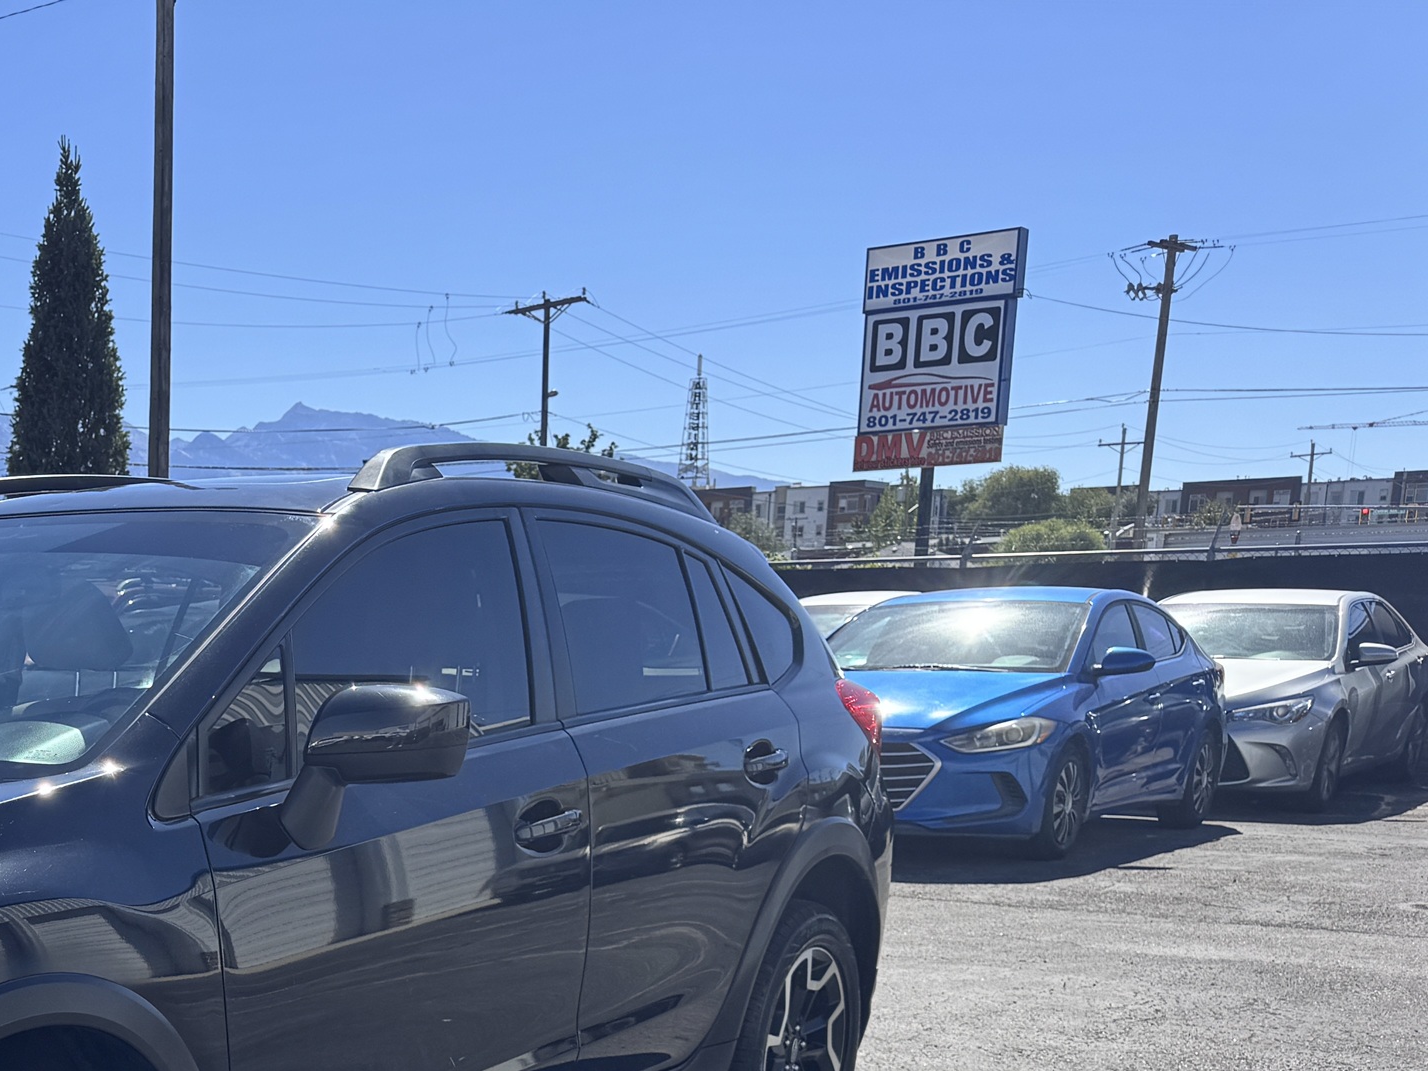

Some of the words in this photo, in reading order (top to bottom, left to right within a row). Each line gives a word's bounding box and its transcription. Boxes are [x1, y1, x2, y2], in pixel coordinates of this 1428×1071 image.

[868, 253, 993, 284] EMISSIONS
[998, 252, 1016, 266] &
[867, 267, 1016, 300] INSPECTIONS
[892, 287, 984, 305] 801-747-2819
[874, 311, 995, 367] BBC
[869, 383, 995, 413] AUTOMOTIVE
[866, 406, 992, 429] 801-747-2819
[855, 432, 927, 462] DMV
